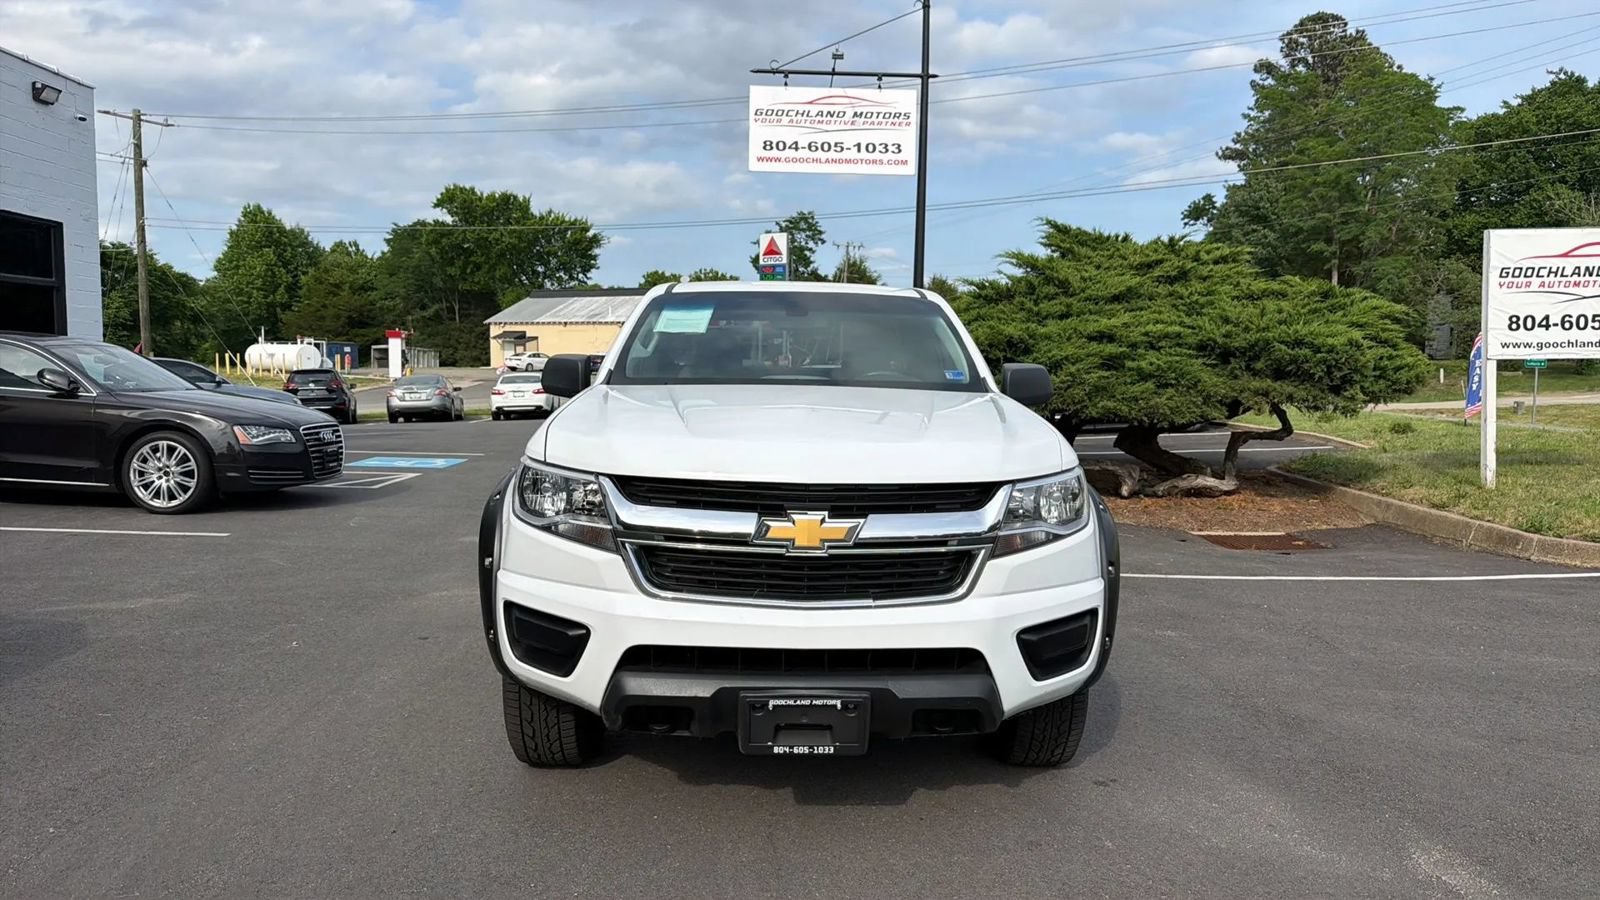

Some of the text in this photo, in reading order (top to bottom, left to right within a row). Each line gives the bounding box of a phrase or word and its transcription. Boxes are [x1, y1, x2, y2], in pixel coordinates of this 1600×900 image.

[754, 108, 912, 120] GOOCHLAND MOTORS
[754, 117, 783, 125] YOUR
[787, 118, 857, 126] AUTOMOTIVE
[762, 139, 903, 155] 804-605-1033
[756, 156, 909, 166] WWW.GOOCHLANDMOTORS.COM
[1499, 280, 1532, 289] YOUR
[773, 746, 834, 754] 804-605-1033
